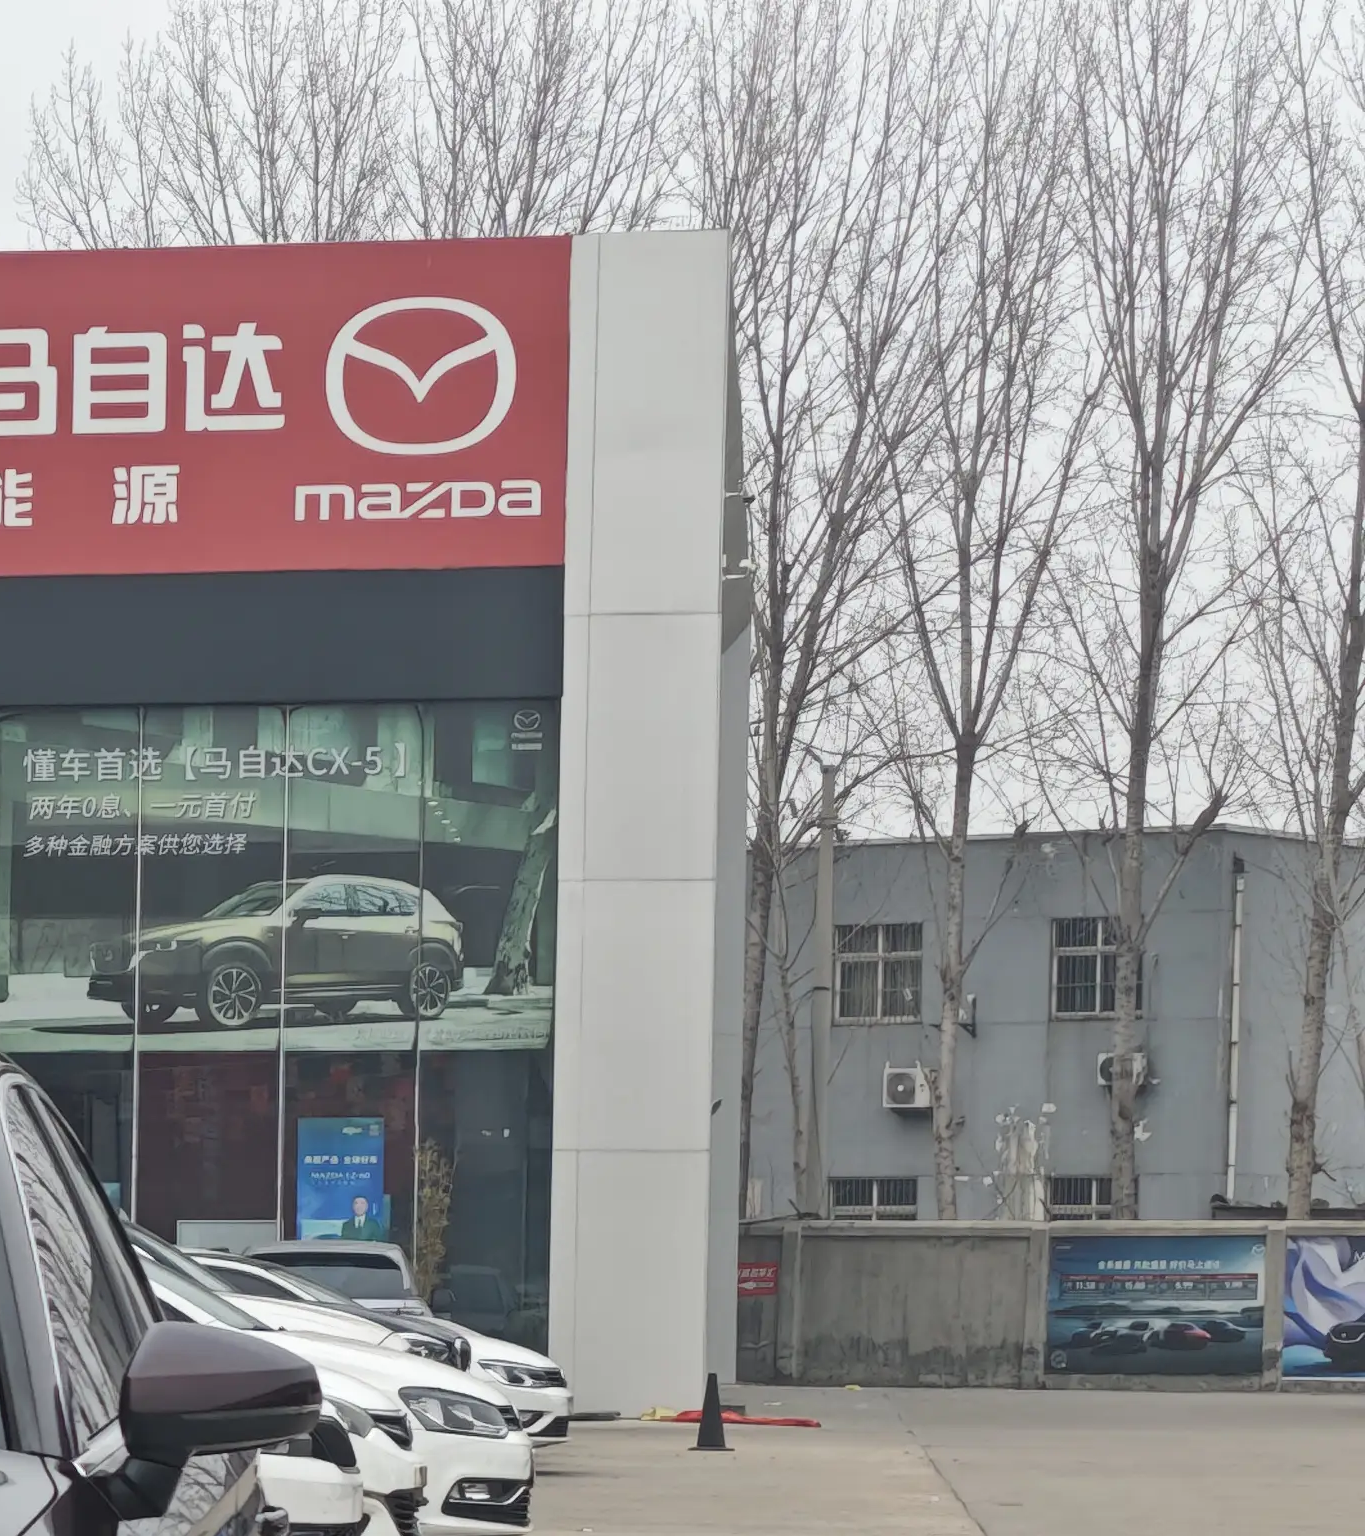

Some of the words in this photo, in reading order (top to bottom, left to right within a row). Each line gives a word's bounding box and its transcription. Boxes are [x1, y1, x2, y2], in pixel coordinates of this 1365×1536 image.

[28, 793, 257, 822] 两年0息、一元首付
[23, 833, 248, 858] 多种金融方案供您选择
